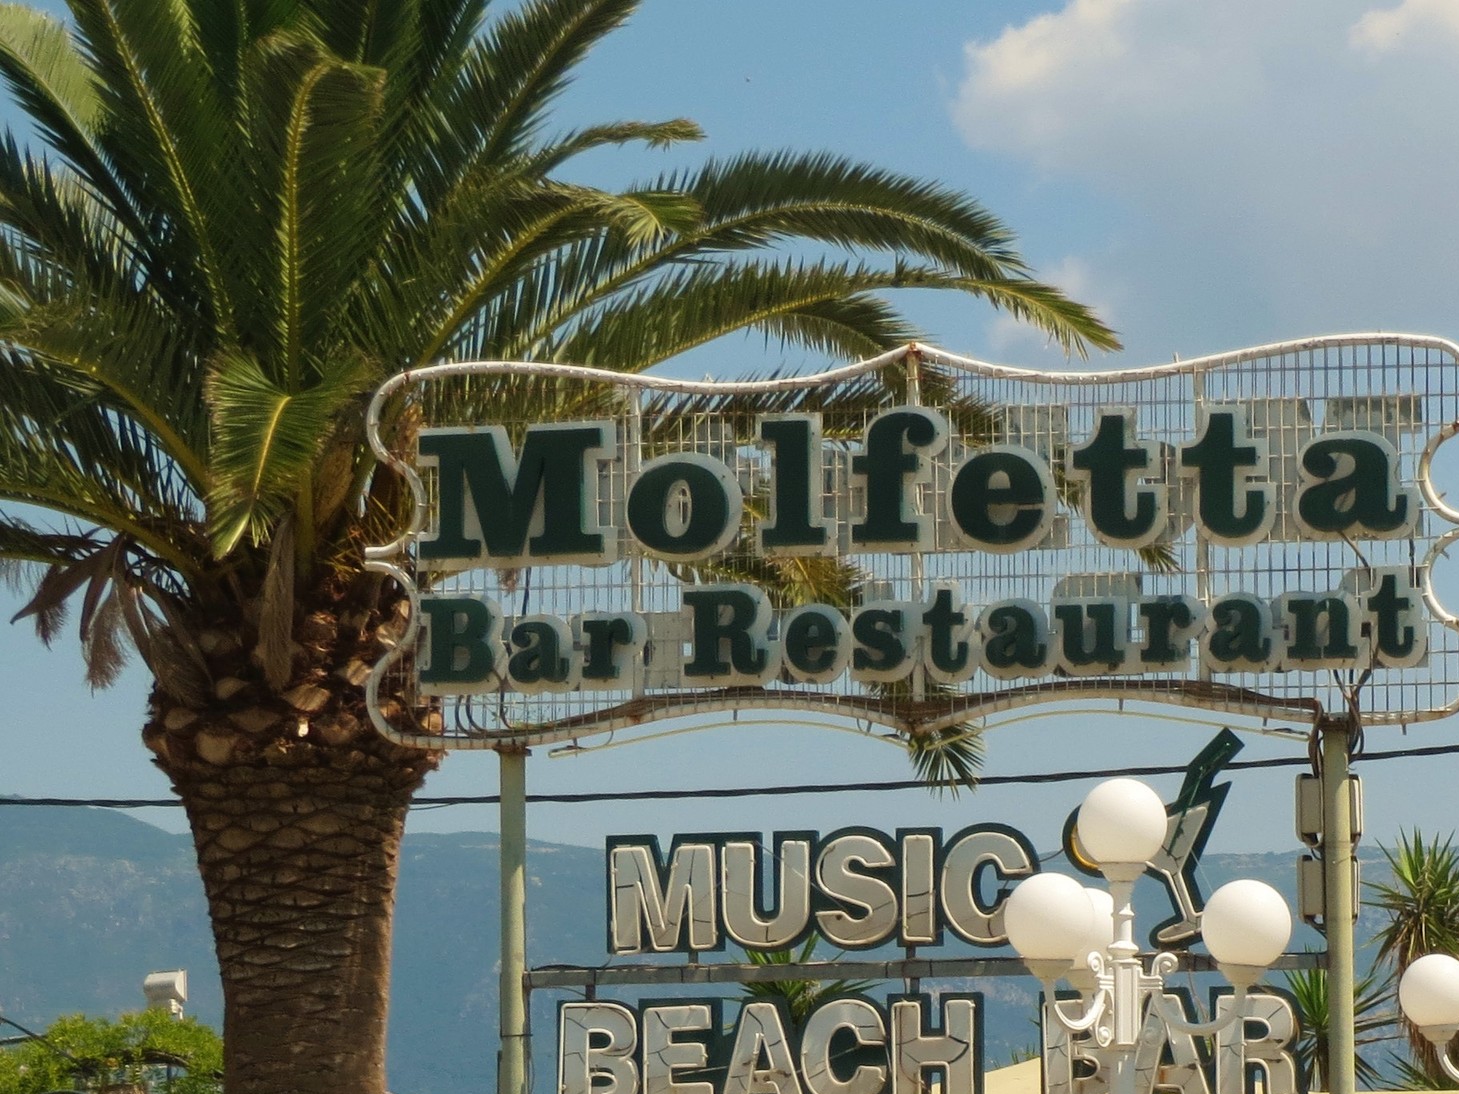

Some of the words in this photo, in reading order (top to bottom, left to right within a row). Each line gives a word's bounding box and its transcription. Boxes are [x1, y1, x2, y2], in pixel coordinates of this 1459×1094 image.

[420, 411, 1412, 562] Molfetta
[420, 597, 644, 692] Bar
[684, 573, 1425, 684] Restaurant
[608, 825, 1040, 952] MUSIC
